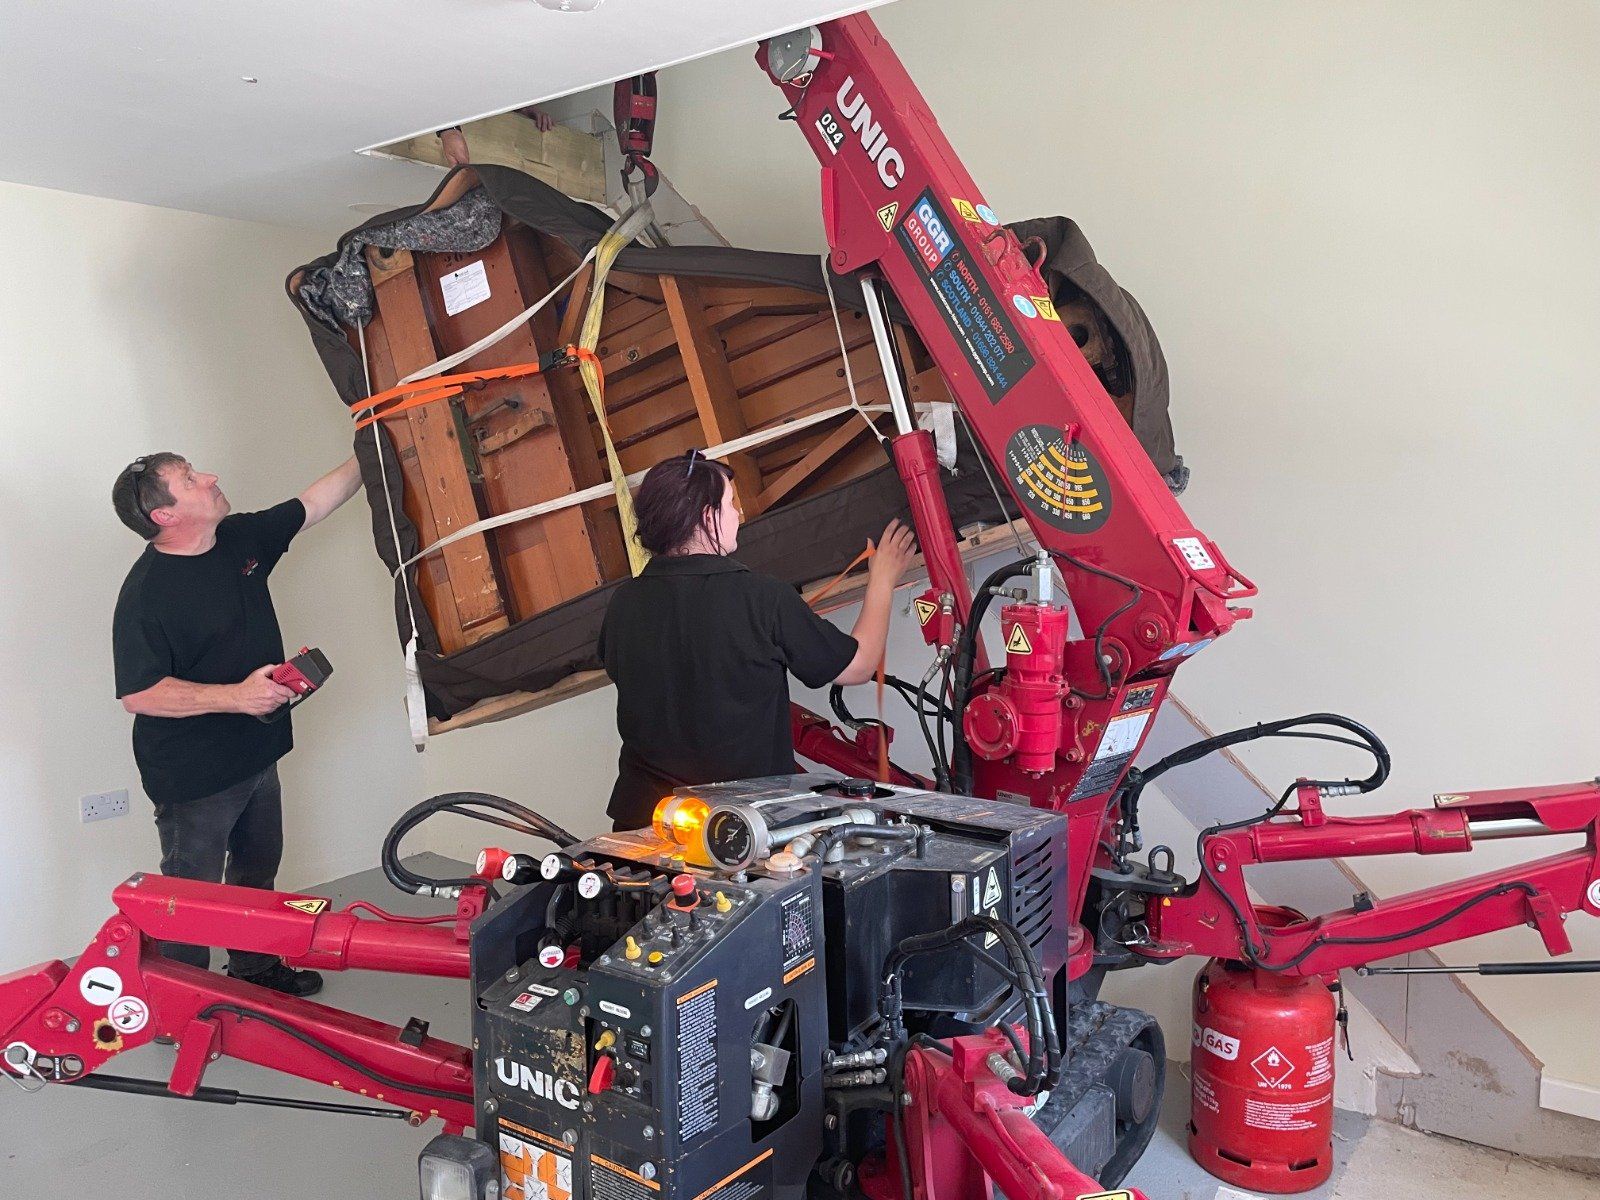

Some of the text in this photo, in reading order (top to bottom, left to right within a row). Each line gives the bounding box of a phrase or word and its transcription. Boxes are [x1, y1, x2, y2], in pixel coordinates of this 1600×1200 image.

[821, 113, 843, 145] 094
[836, 76, 904, 187] UNIC
[908, 219, 938, 262] GROUP
[919, 204, 950, 253] GGR
[948, 269, 970, 303] SOUTH
[970, 305, 988, 332] 01844
[983, 330, 997, 347] 202
[992, 344, 1005, 362] 071
[955, 259, 979, 294] NORTH
[977, 296, 993, 319] 0161
[990, 316, 1002, 334] 683
[998, 331, 1014, 354] 2580
[940, 279, 972, 328] SCOTLAND
[994, 371, 1008, 389] 444
[1206, 1034, 1234, 1055] GAS
[494, 1057, 580, 1110] UNIC
